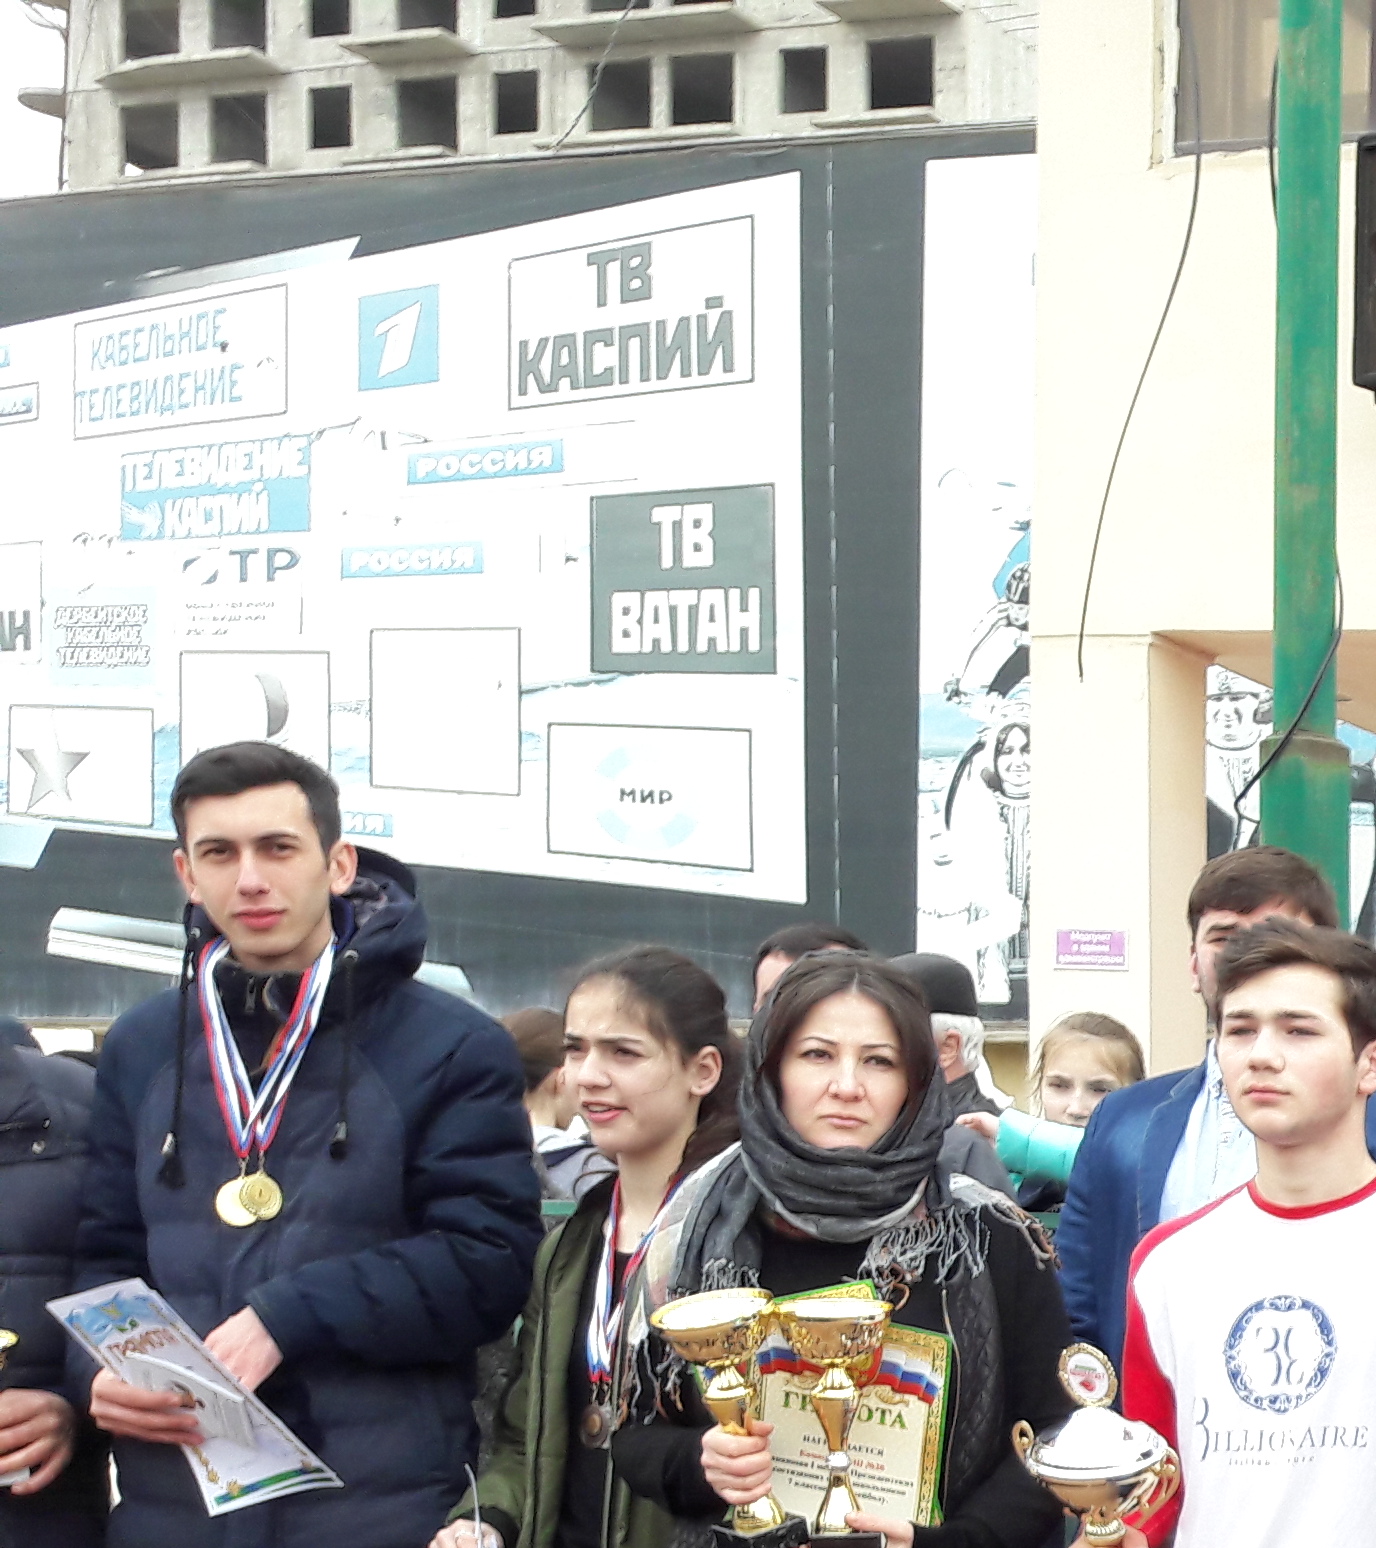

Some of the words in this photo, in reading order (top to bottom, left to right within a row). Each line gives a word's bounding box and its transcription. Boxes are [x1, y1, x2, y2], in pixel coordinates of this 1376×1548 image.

[587, 241, 653, 308] ТВ
[90, 308, 227, 371] КАБЕЛЬНОЕ
[518, 296, 735, 396] КАСПИЙ
[75, 362, 244, 423] ТЕЛЕВИДЕНИЕ
[122, 436, 310, 492] ТЕЛЕВИДЕНИЕ
[415, 445, 553, 480] РОССИЯ
[163, 481, 271, 539] КАСПИЙ
[650, 502, 716, 571] ТВ
[350, 546, 475, 574] РОССИЯ
[611, 586, 762, 654] ВАТАН
[619, 788, 673, 805] МИР
[1193, 1397, 1368, 1461] BILLIONAIRE
